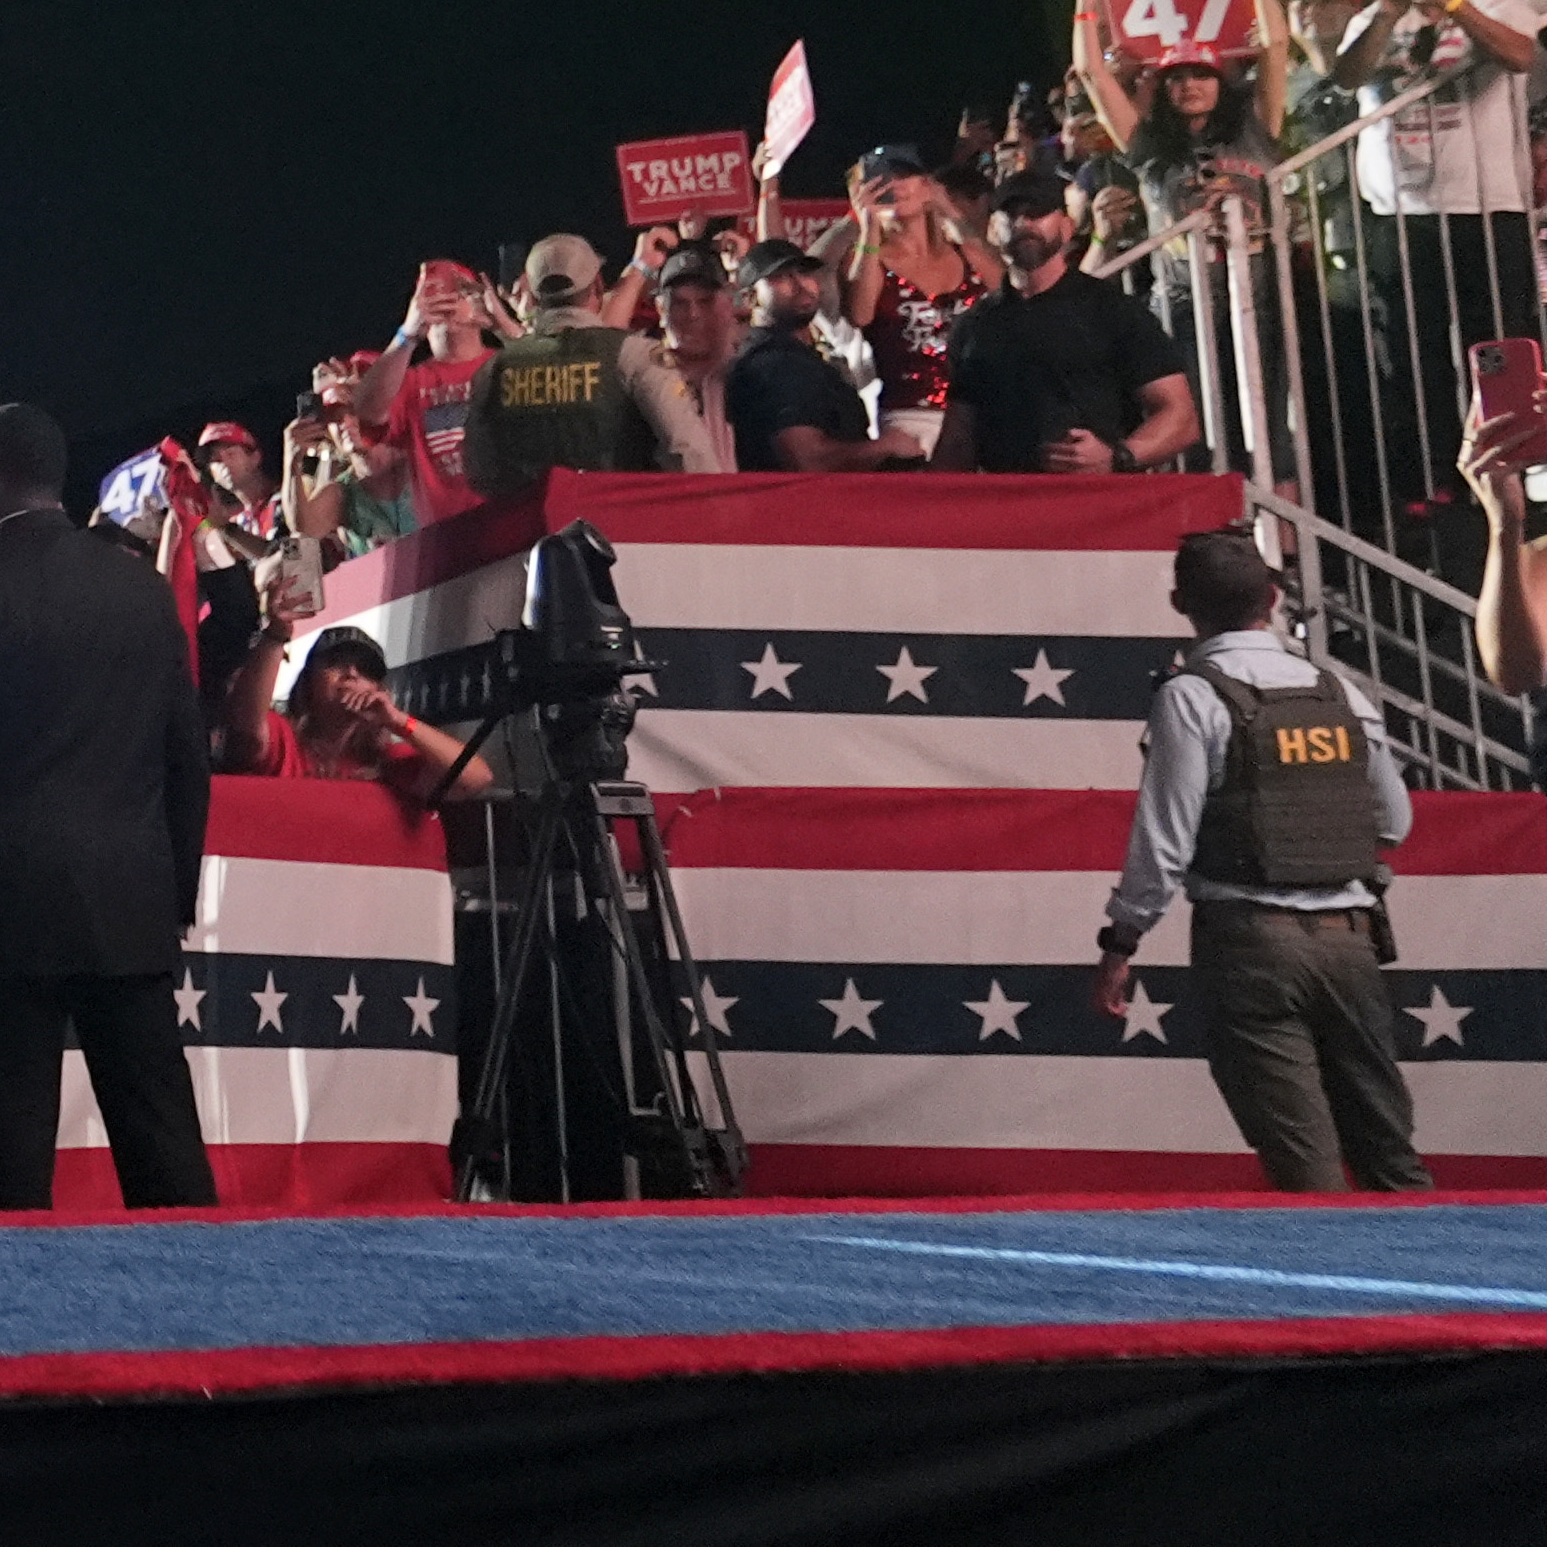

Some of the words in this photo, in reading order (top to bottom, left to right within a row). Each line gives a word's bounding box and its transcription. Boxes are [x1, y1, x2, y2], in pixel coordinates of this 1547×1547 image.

[627, 151, 742, 184] TRUMP
[642, 172, 732, 198] VANCE
[502, 361, 601, 406] SHERIFF
[101, 453, 163, 516] 47
[1276, 725, 1350, 764] HSI
